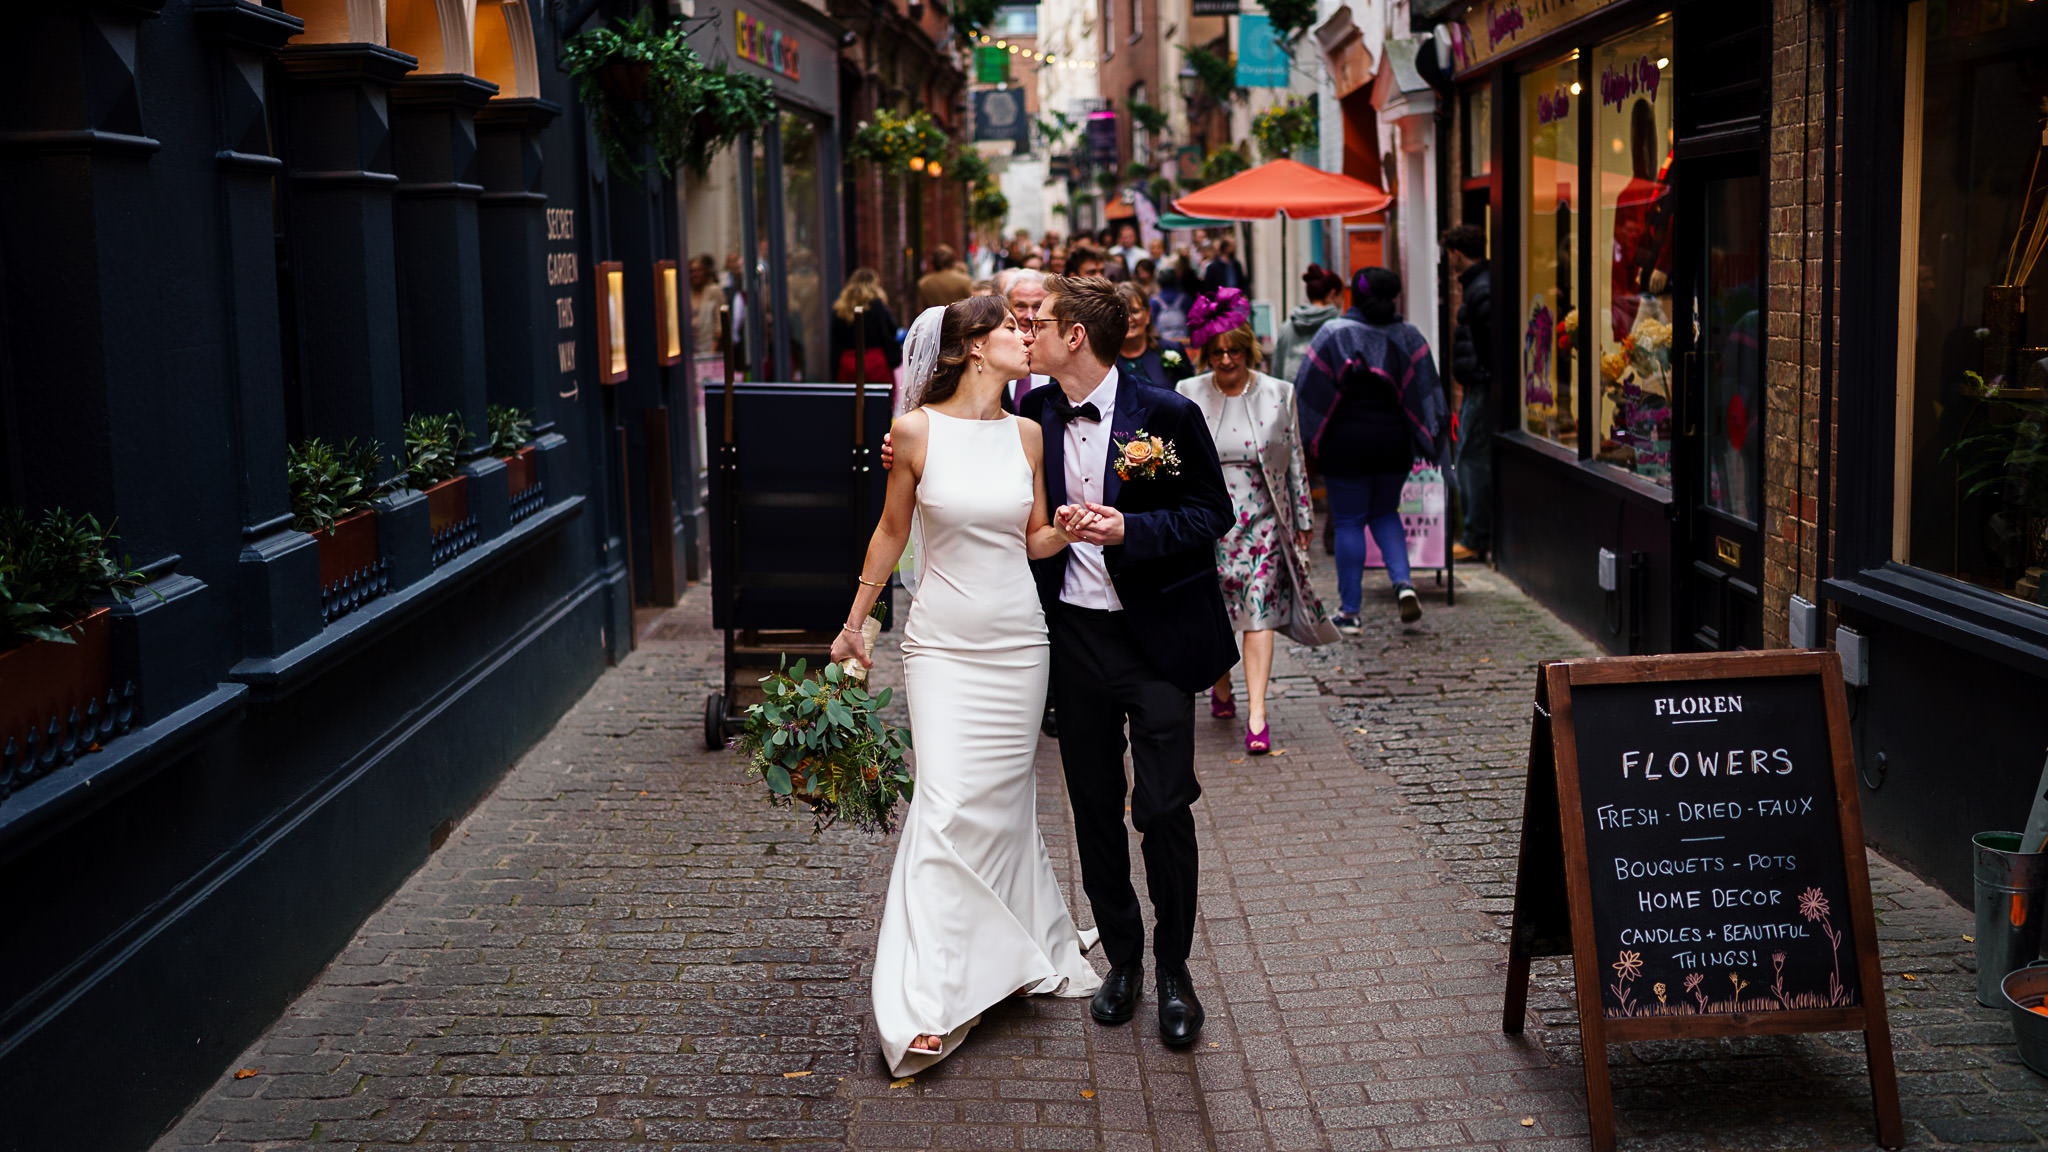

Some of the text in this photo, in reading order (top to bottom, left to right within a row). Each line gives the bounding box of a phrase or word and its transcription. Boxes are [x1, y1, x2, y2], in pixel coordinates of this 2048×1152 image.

[546, 208, 574, 240] SECRET
[548, 253, 578, 286] GARDEN
[556, 297, 573, 328] THIS
[558, 341, 576, 373] WAY
[1655, 696, 1742, 715] FLOREN
[1623, 749, 1792, 780] FLOWERS
[1597, 804, 1658, 830] FRESH
[1679, 802, 1741, 821] DRIED
[1758, 797, 1812, 816] FAUX
[1615, 858, 1724, 880] BOUQUETS
[1749, 854, 1795, 870] POTS
[1639, 889, 1781, 912] HOME DECOR
[1621, 928, 1701, 945] CANDLES
[1723, 924, 1809, 942] BEAUTIFUL
[1672, 950, 1757, 968] THINGS!
